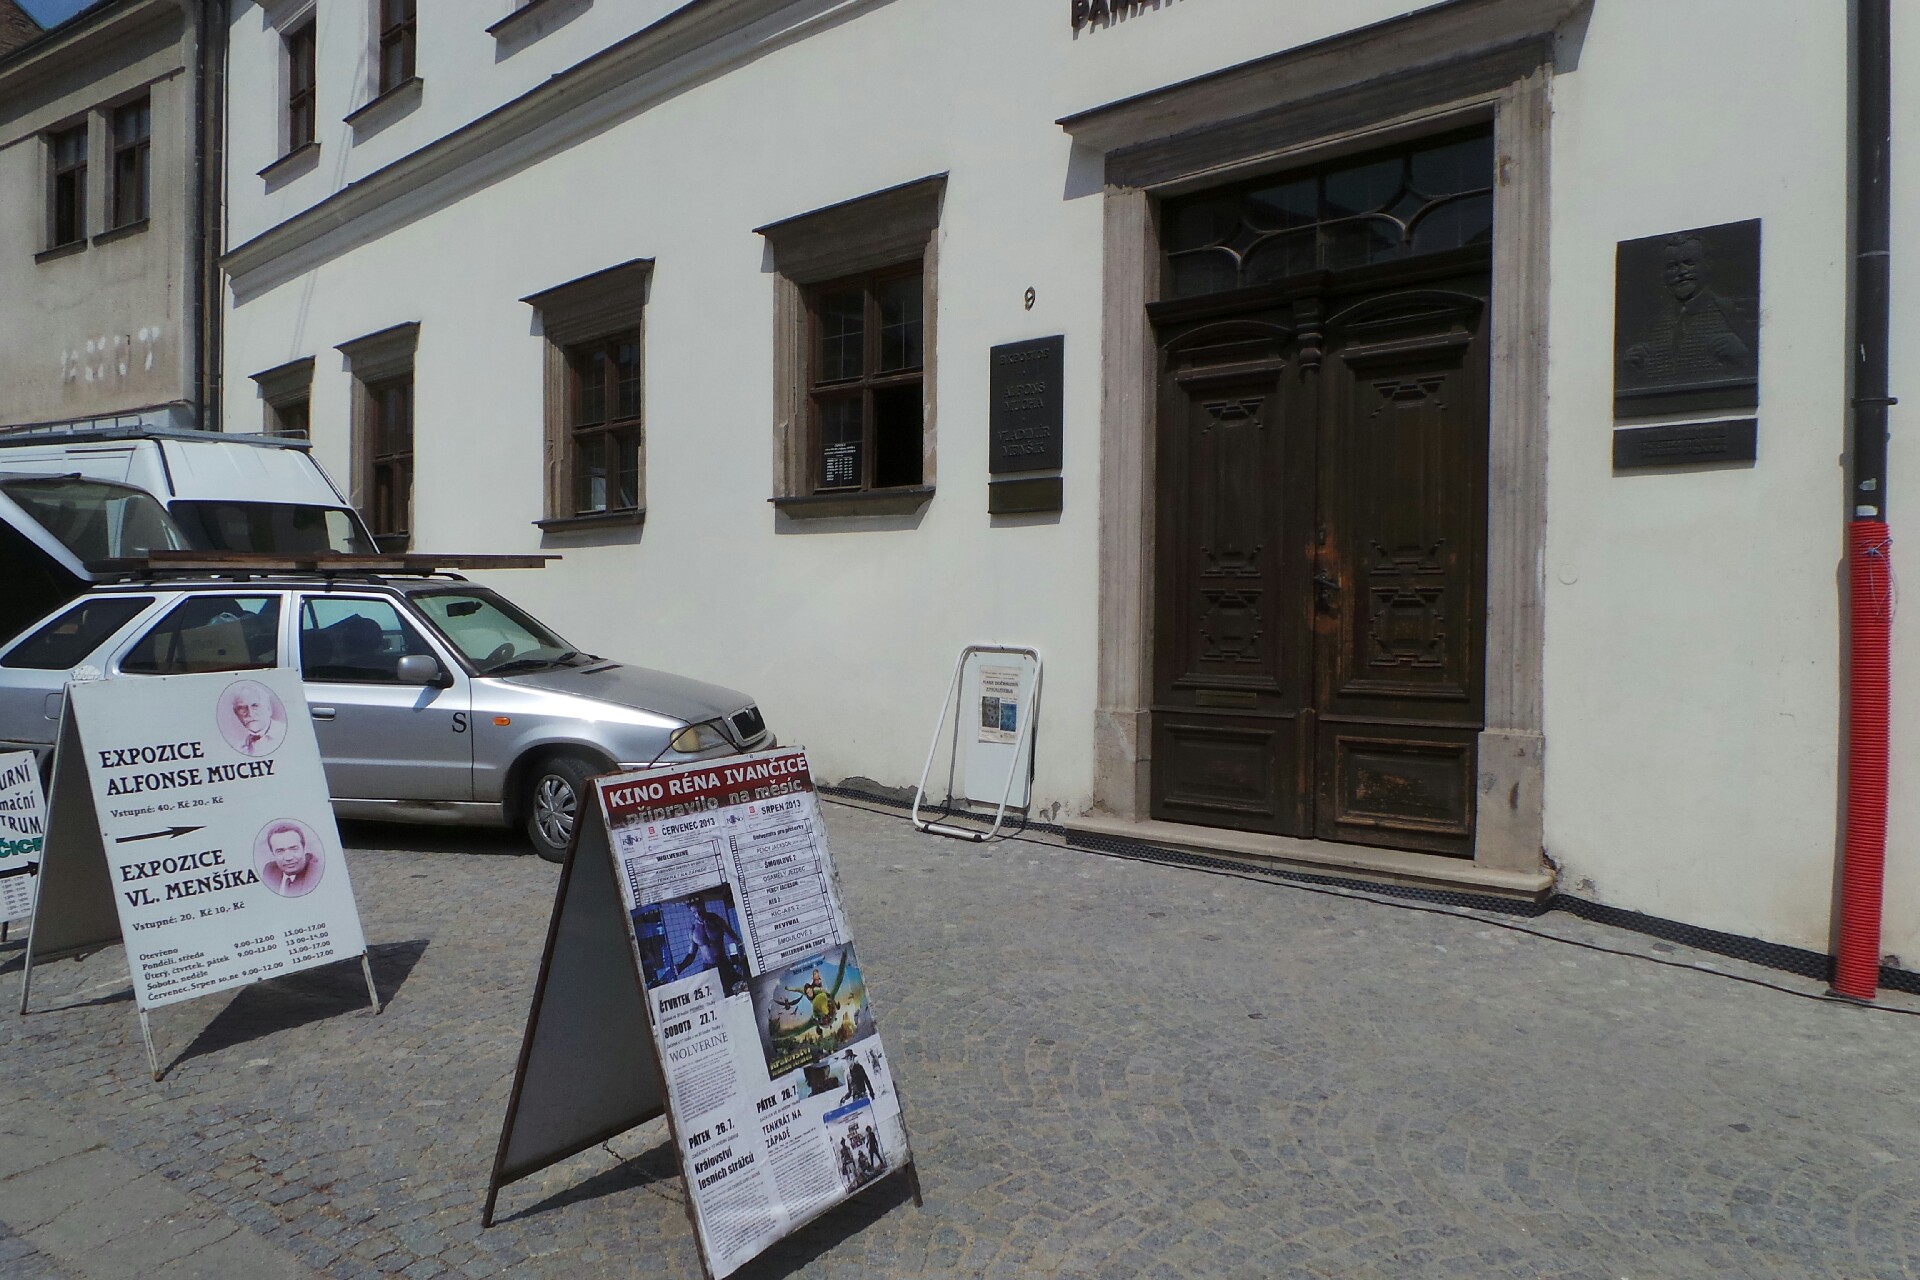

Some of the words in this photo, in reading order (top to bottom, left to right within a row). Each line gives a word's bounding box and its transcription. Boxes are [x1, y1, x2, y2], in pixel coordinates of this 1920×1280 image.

[1024, 286, 1035, 311] 9
[452, 712, 467, 733] S
[98, 741, 205, 769] EXPOZICE
[107, 769, 202, 796] ALFONSE
[207, 760, 275, 783] MUCHY
[609, 784, 664, 808] KINO
[669, 772, 721, 796] RÉNA
[724, 757, 808, 785] IVANČICE
[111, 805, 155, 818] Vstupné:
[177, 800, 190, 809] Kč
[212, 796, 224, 805] Kč
[626, 796, 719, 826] připravilo
[728, 790, 750, 805] na
[755, 776, 803, 800] měsíc
[761, 803, 785, 815] SRPEN
[785, 799, 801, 810] 2013
[662, 822, 699, 836] ČERVENEC
[700, 818, 715, 829] 2013
[120, 849, 226, 882] EXPOZICE
[656, 850, 689, 862] WOLVERINE
[125, 888, 160, 907] VL.
[165, 868, 260, 901] MENŠÍKA
[132, 916, 178, 931] Vstupné:
[200, 908, 213, 917] Kč
[233, 901, 245, 910] Kč
[774, 918, 800, 930] REVIVAL
[139, 948, 178, 961] Otevřeno
[178, 951, 205, 963] středa
[207, 954, 230, 968] pátek
[181, 970, 208, 982] neděle
[660, 992, 691, 1014] ČTVRTEK
[664, 1019, 692, 1039] SOBOTA
[669, 1032, 729, 1063] WOLVERINE
[756, 1094, 777, 1113] PÁTEK
[762, 1114, 790, 1135] TENKRÁT
[791, 1109, 802, 1121] NA
[689, 1129, 712, 1149] PÁTEK
[765, 1126, 790, 1149] ZÁPADĚ
[695, 1145, 733, 1175] Království
[698, 1166, 728, 1190] lesních
[727, 1150, 755, 1175] strážců
